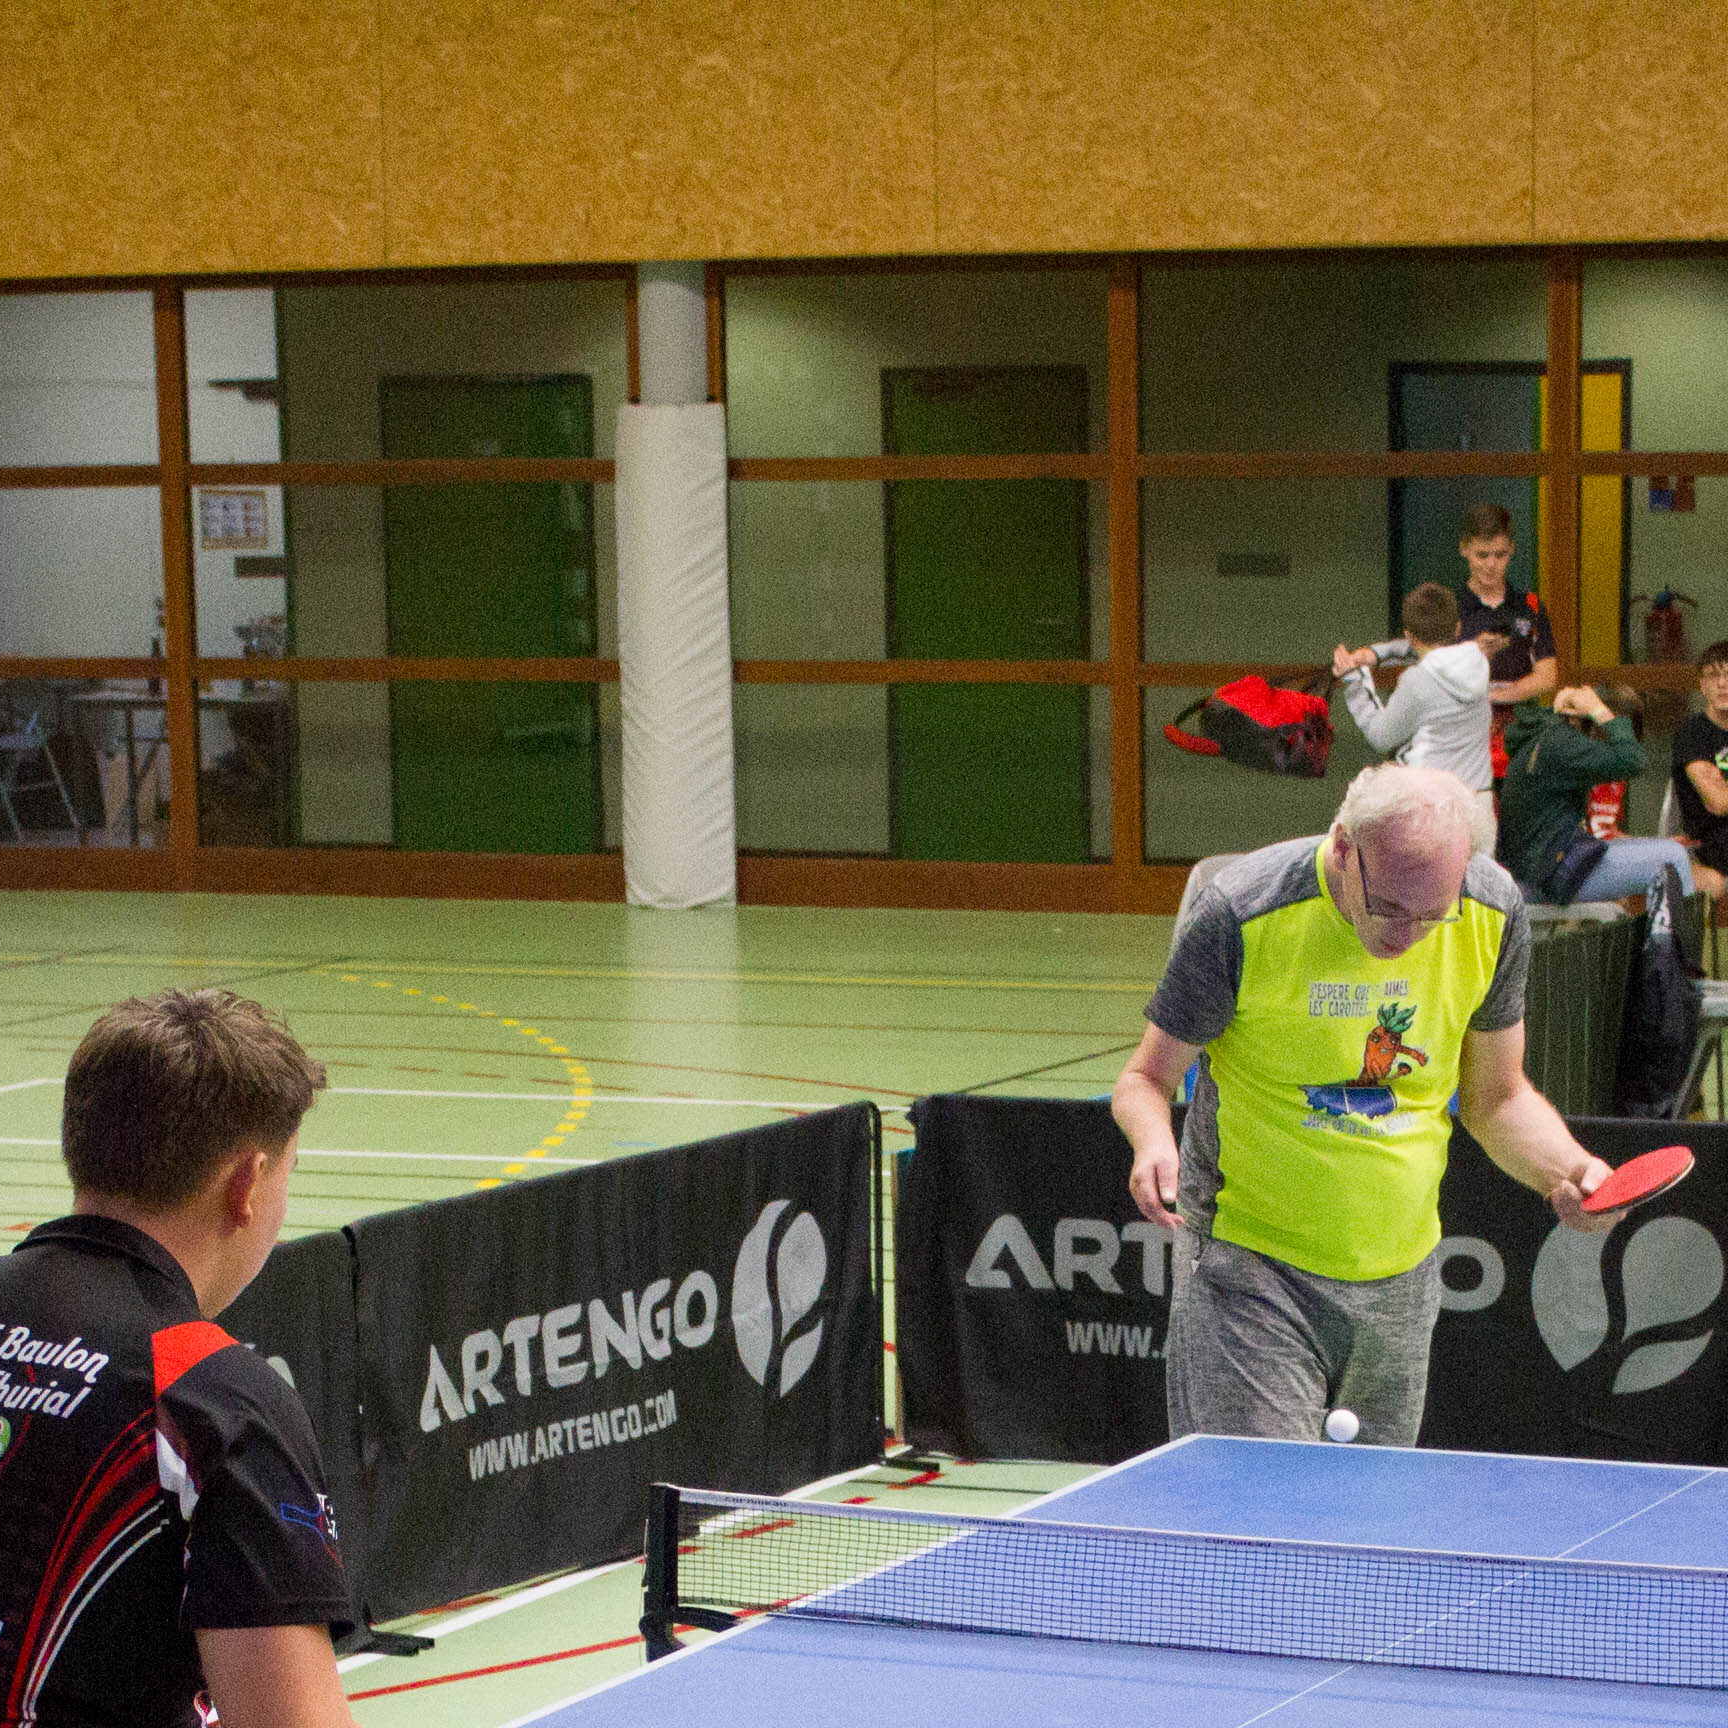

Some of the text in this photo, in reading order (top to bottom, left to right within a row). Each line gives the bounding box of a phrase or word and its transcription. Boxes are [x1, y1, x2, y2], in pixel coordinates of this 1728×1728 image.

[965, 1213, 1507, 1312] ARTO
[419, 1270, 718, 1434] ARTENGO
[468, 1389, 677, 1481] WWW.ARTENGO.COM
